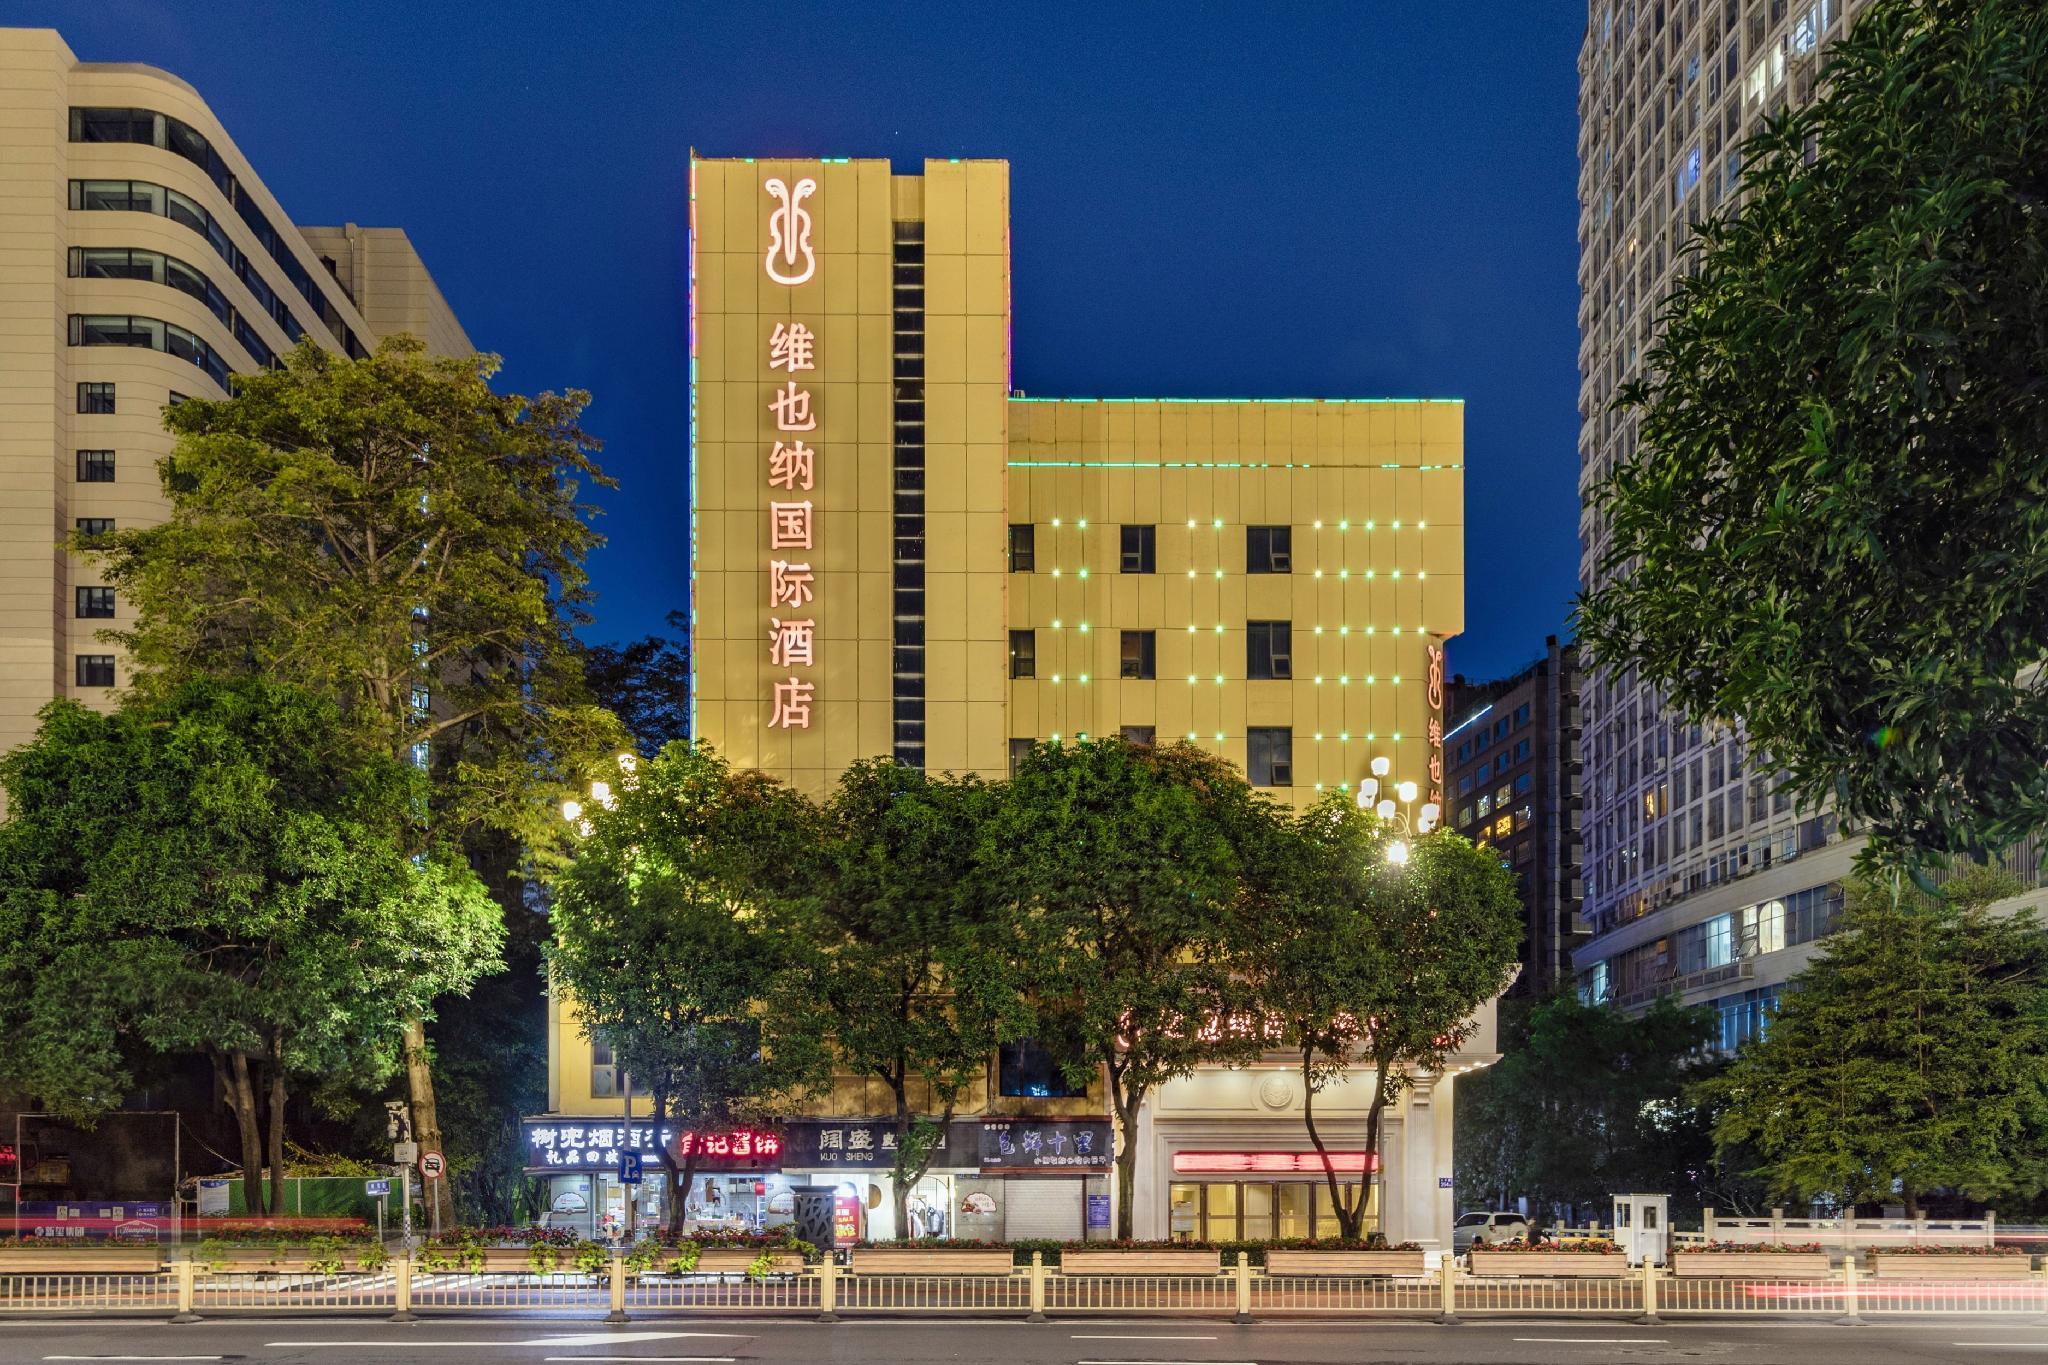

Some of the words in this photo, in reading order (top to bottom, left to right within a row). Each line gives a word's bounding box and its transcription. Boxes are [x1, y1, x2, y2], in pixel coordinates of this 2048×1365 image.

[767, 321, 817, 730] 维也纳国际酒店
[818, 1128, 875, 1150] 阔盛
